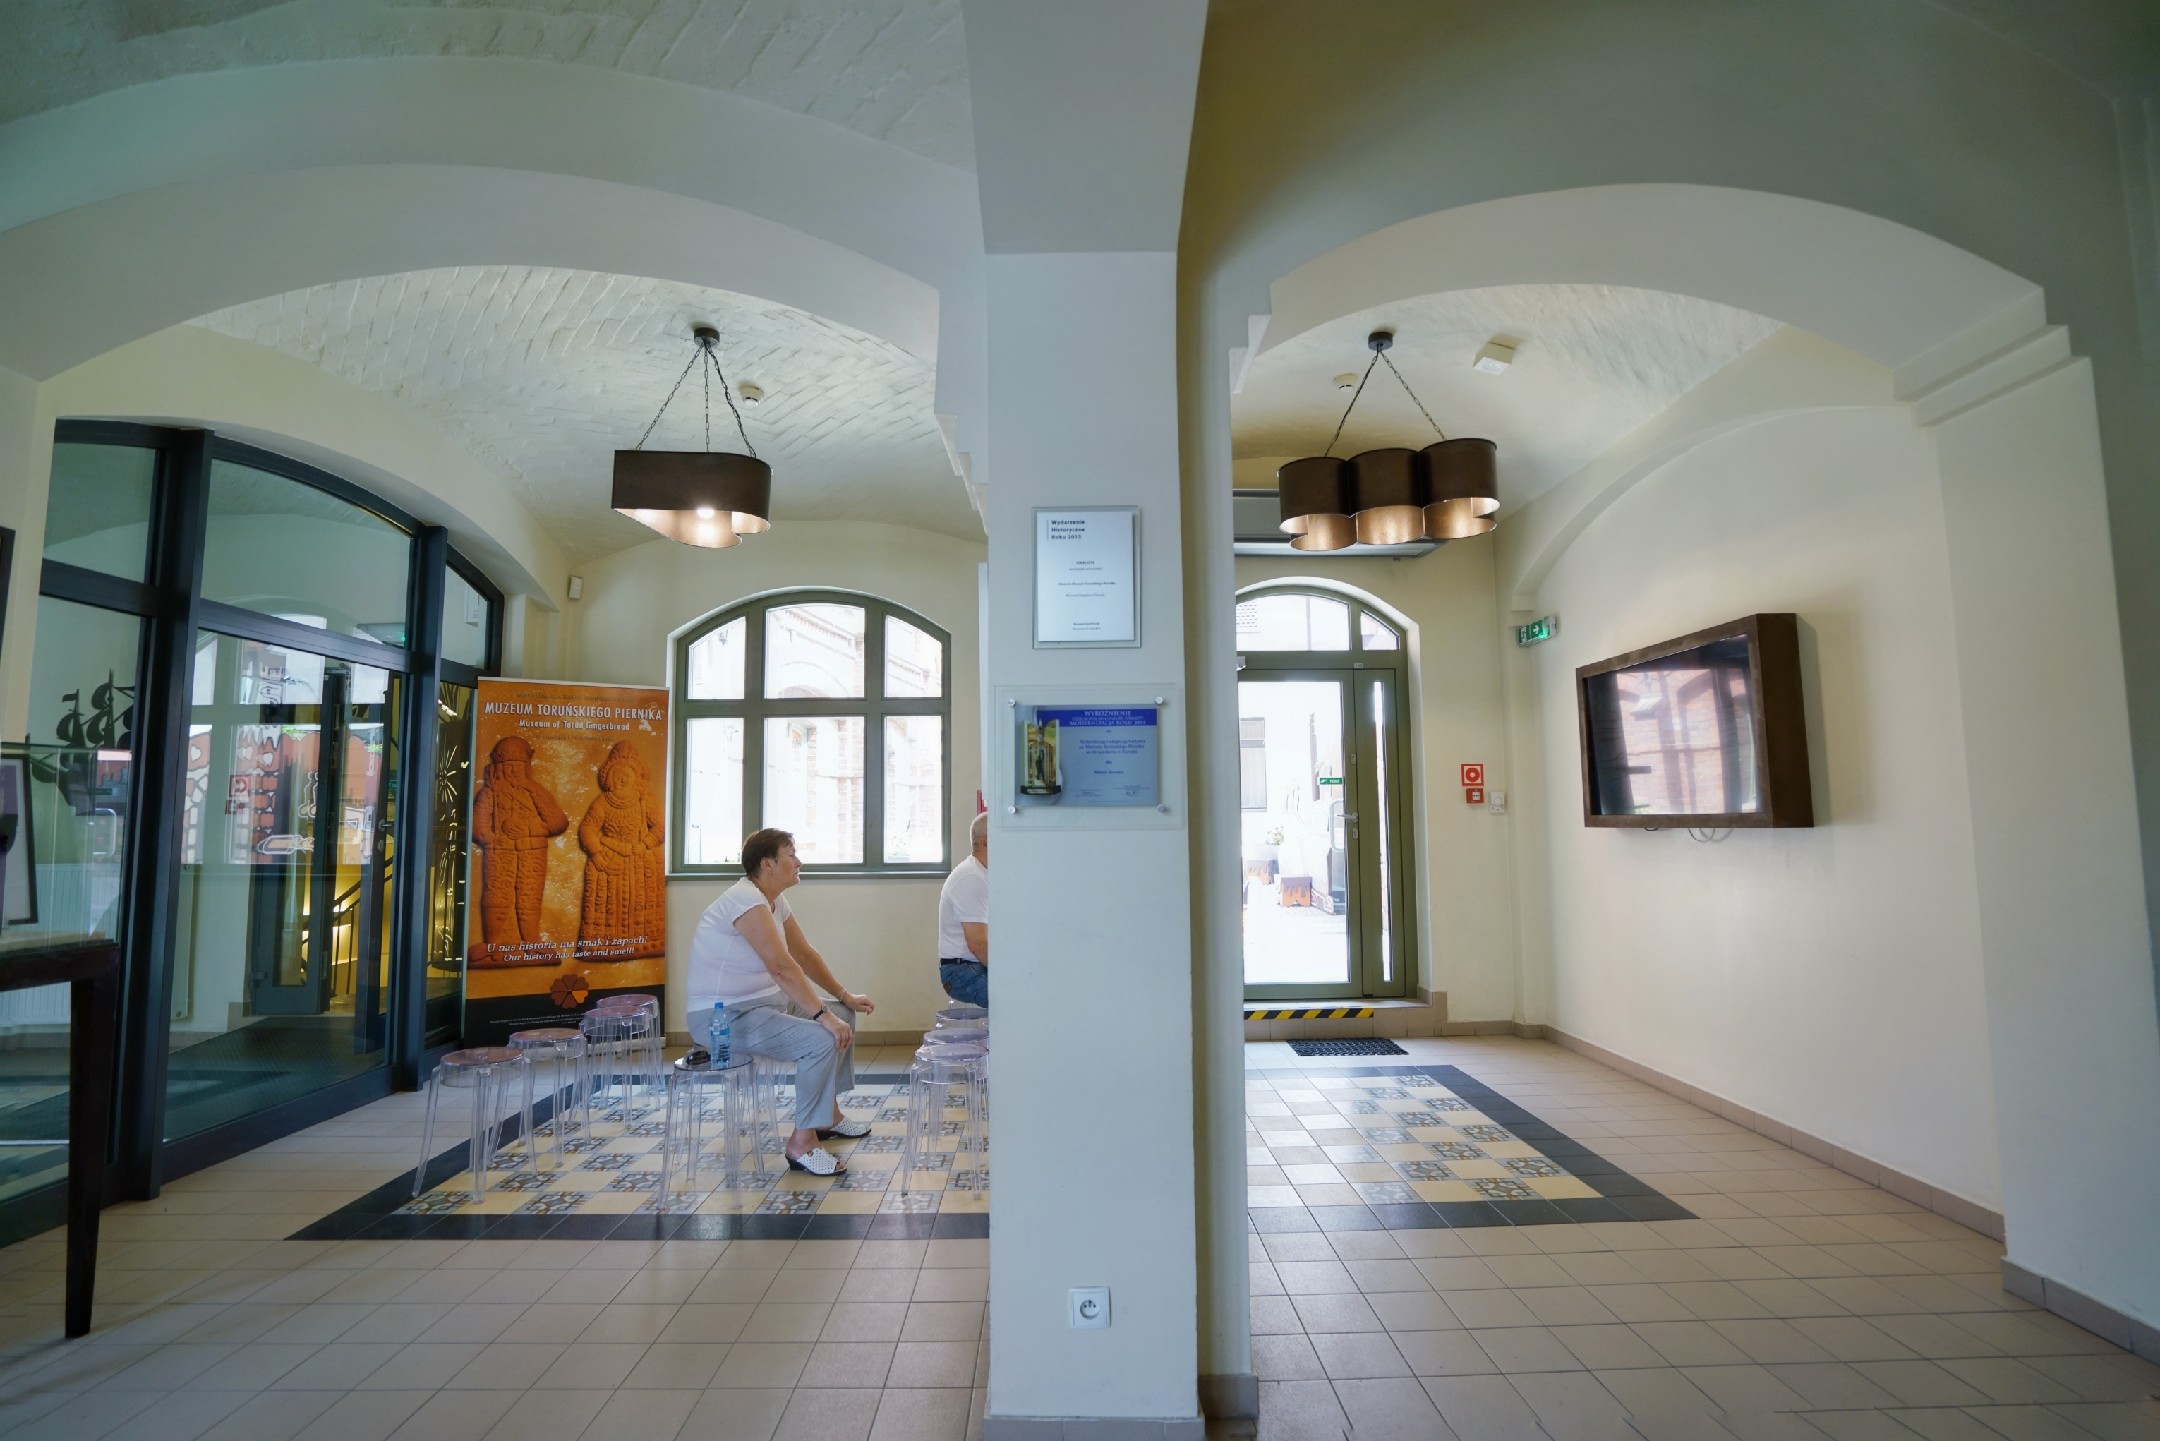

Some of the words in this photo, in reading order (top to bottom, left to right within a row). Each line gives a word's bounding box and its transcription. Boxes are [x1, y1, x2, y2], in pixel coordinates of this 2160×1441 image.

[484, 702, 533, 715] MUZEUM
[537, 703, 611, 719] TORUŃSKIEGO
[614, 708, 662, 721] PIERNIKA
[518, 719, 550, 728] Museum
[553, 720, 560, 729] of
[585, 722, 630, 732] Gingerbread
[487, 943, 496, 953] U
[498, 944, 516, 952] nas
[518, 940, 557, 951] historia
[560, 941, 575, 949] ma
[577, 937, 603, 948] smak
[605, 936, 610, 946] i
[611, 935, 648, 947] zapach!
[503, 954, 522, 962] Our
[523, 951, 553, 961] history
[555, 951, 570, 959] has
[572, 949, 592, 958] taste
[592, 948, 609, 956] and
[610, 947, 635, 956] smell!
